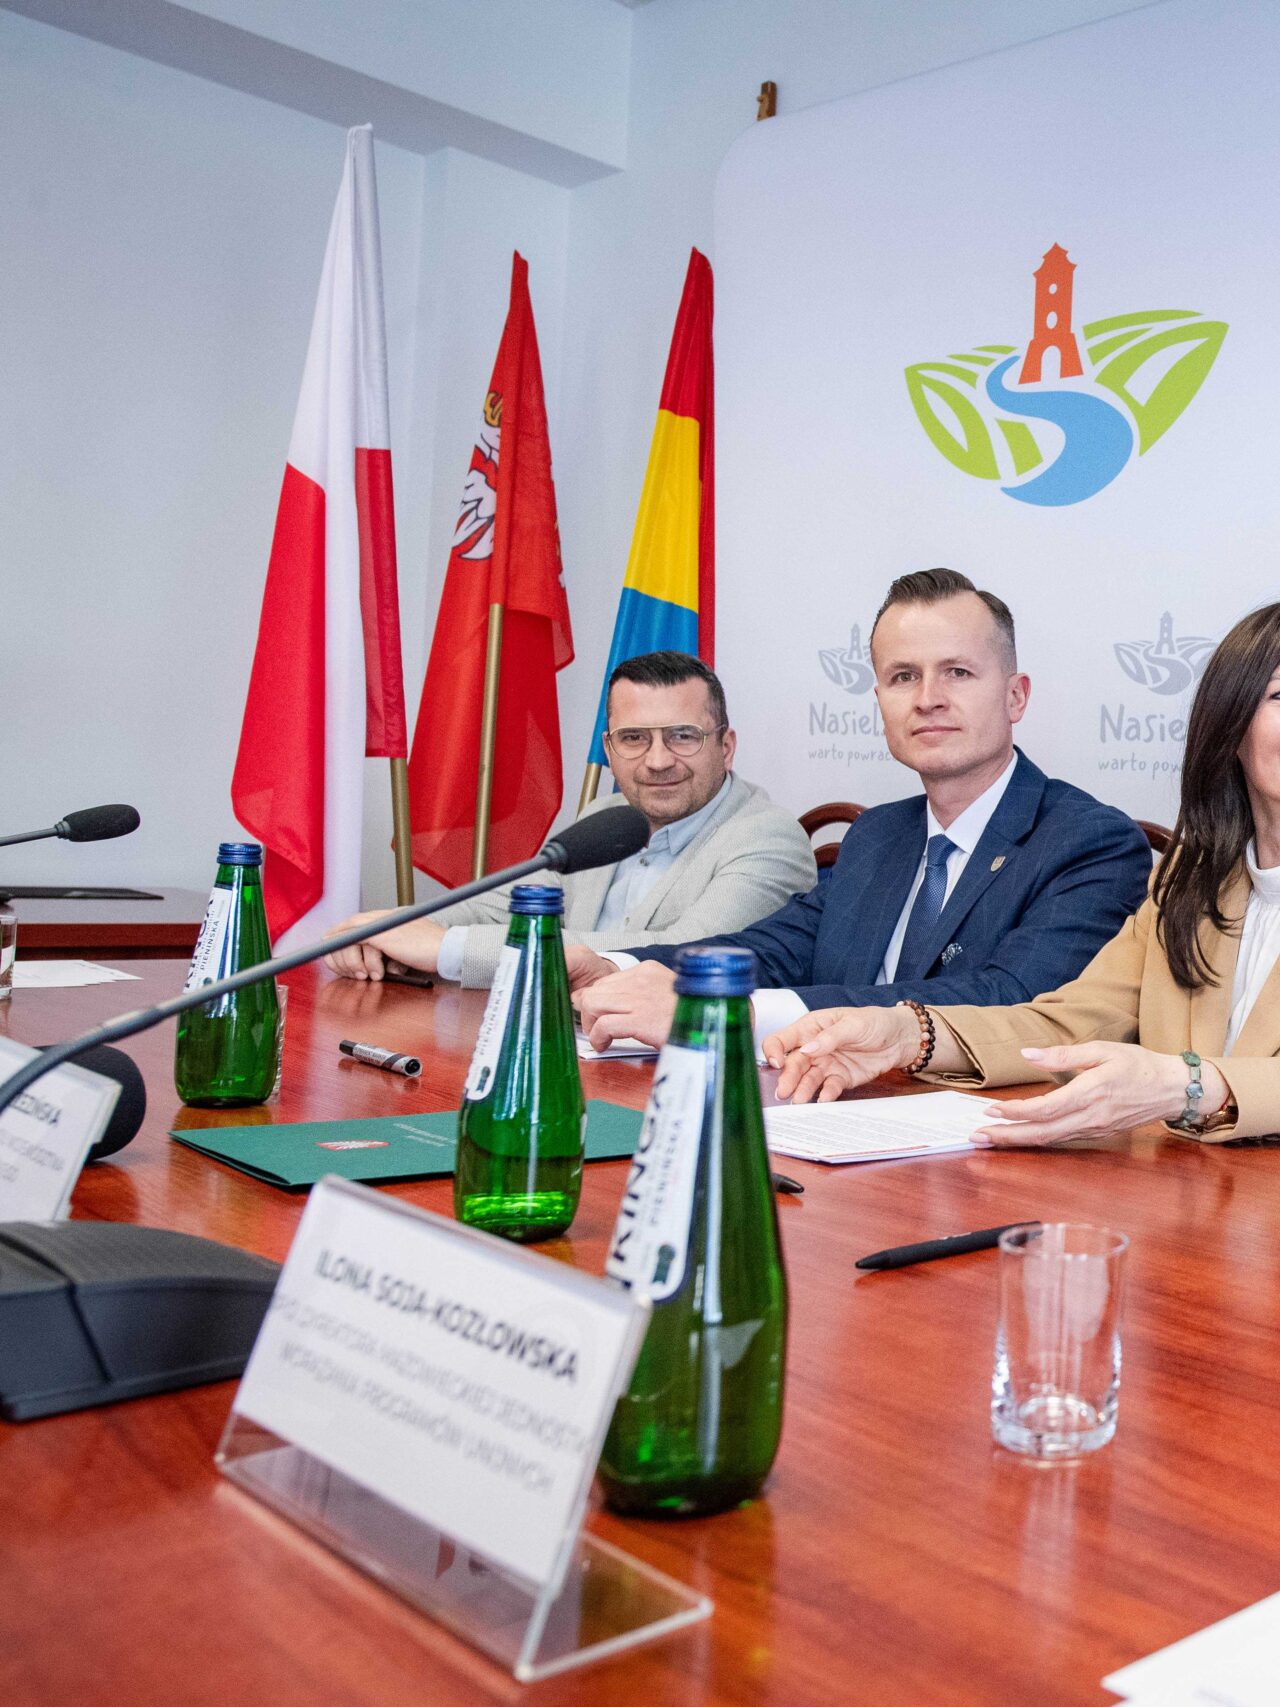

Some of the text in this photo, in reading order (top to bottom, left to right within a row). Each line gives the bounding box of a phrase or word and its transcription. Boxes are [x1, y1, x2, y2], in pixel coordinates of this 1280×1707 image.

[808, 702, 886, 737] Nasiel
[1099, 703, 1186, 744] Nasie
[808, 743, 897, 767] warto powrac
[1098, 752, 1147, 771] warto
